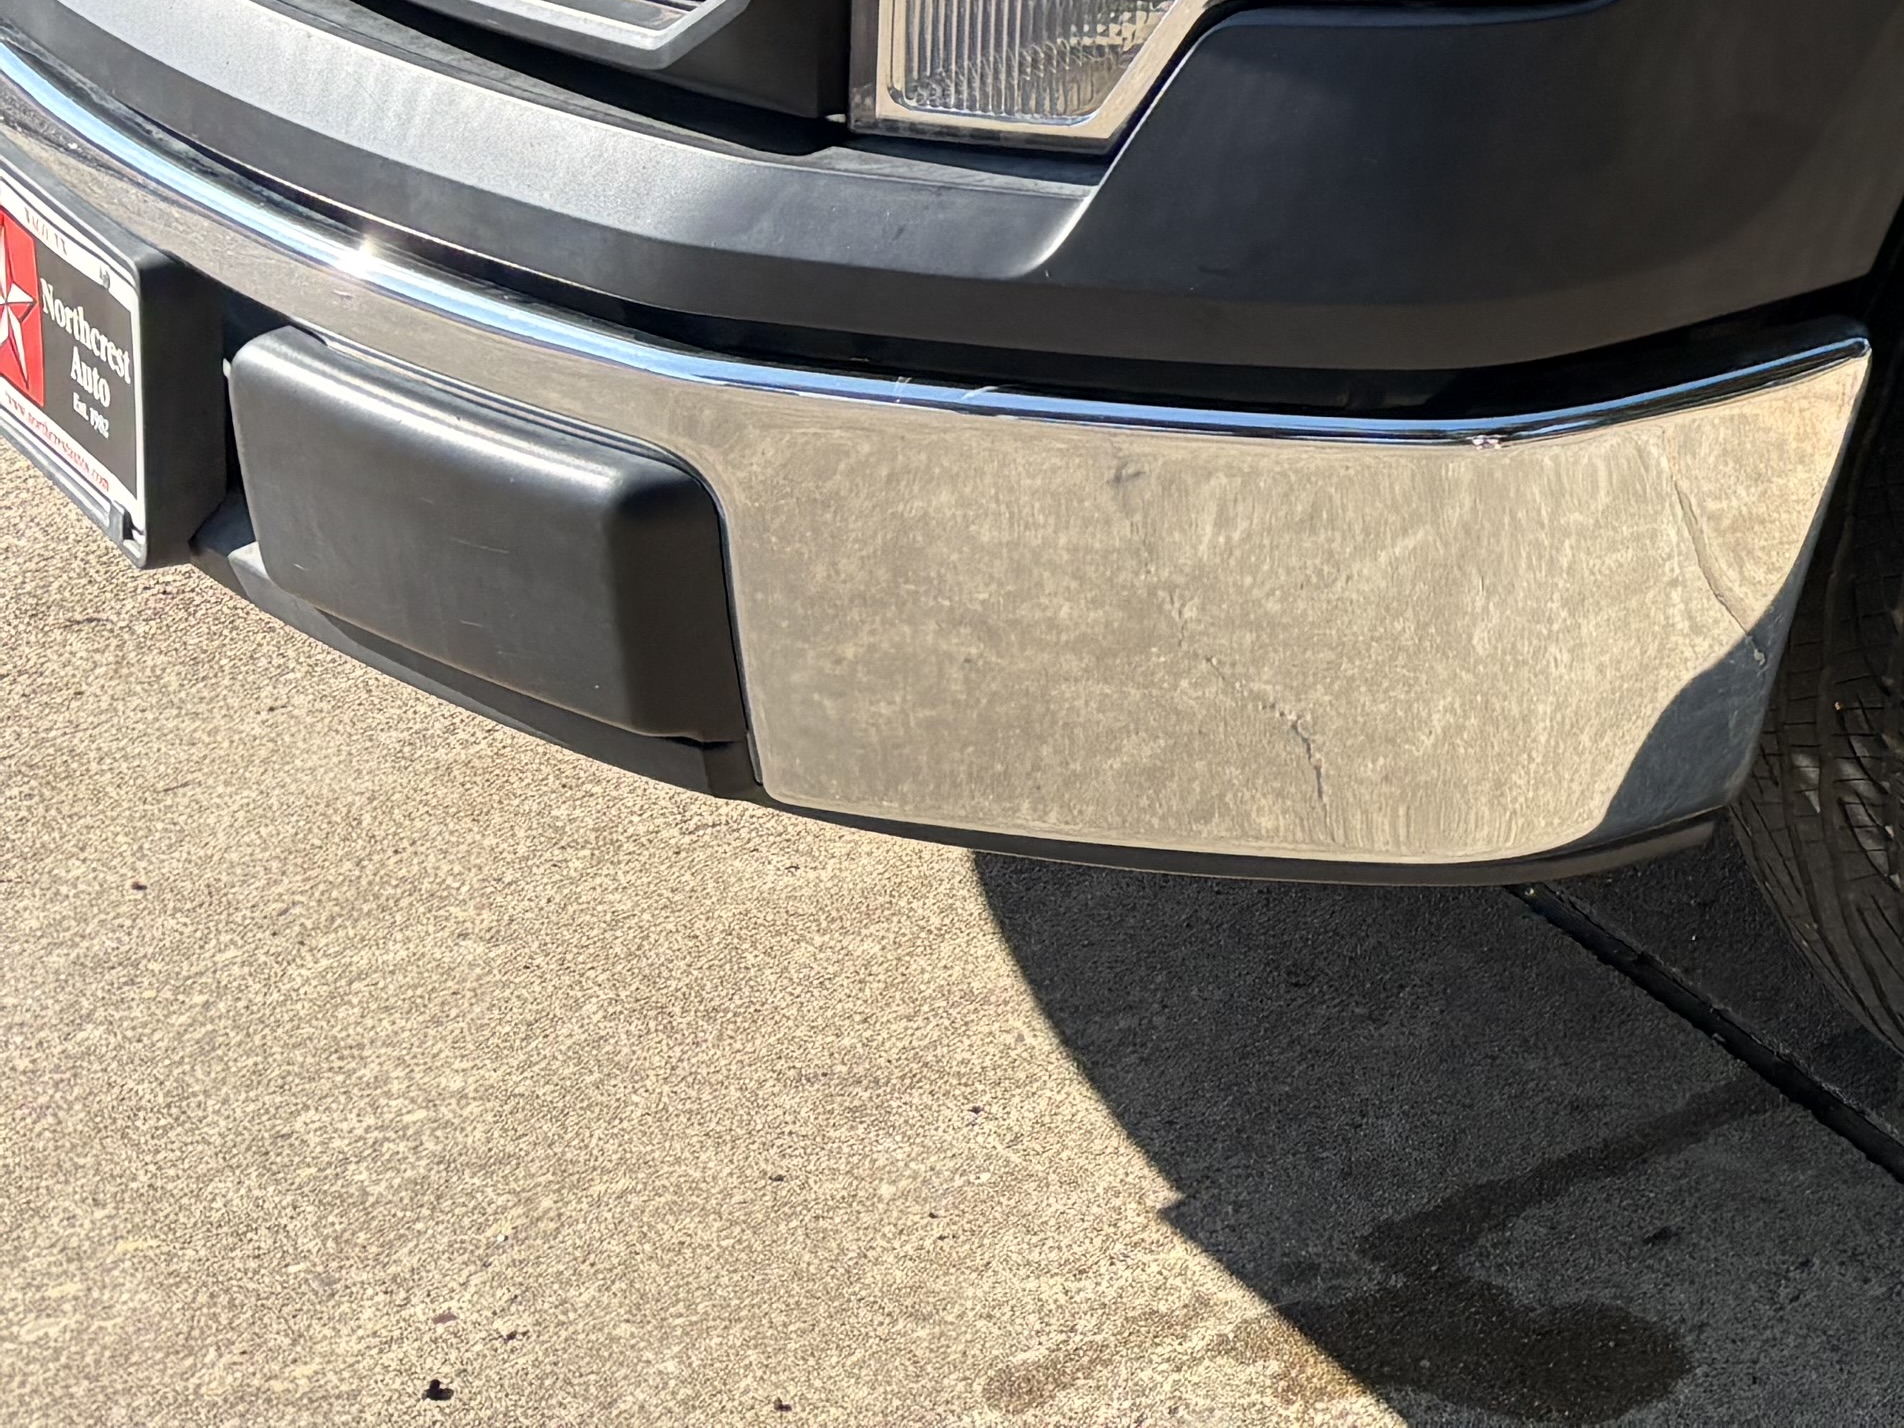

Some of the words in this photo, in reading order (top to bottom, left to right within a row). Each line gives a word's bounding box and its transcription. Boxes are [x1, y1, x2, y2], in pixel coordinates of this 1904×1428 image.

[39, 276, 132, 385] Northcrest
[70, 345, 111, 409] Auto
[89, 406, 110, 440] 1982
